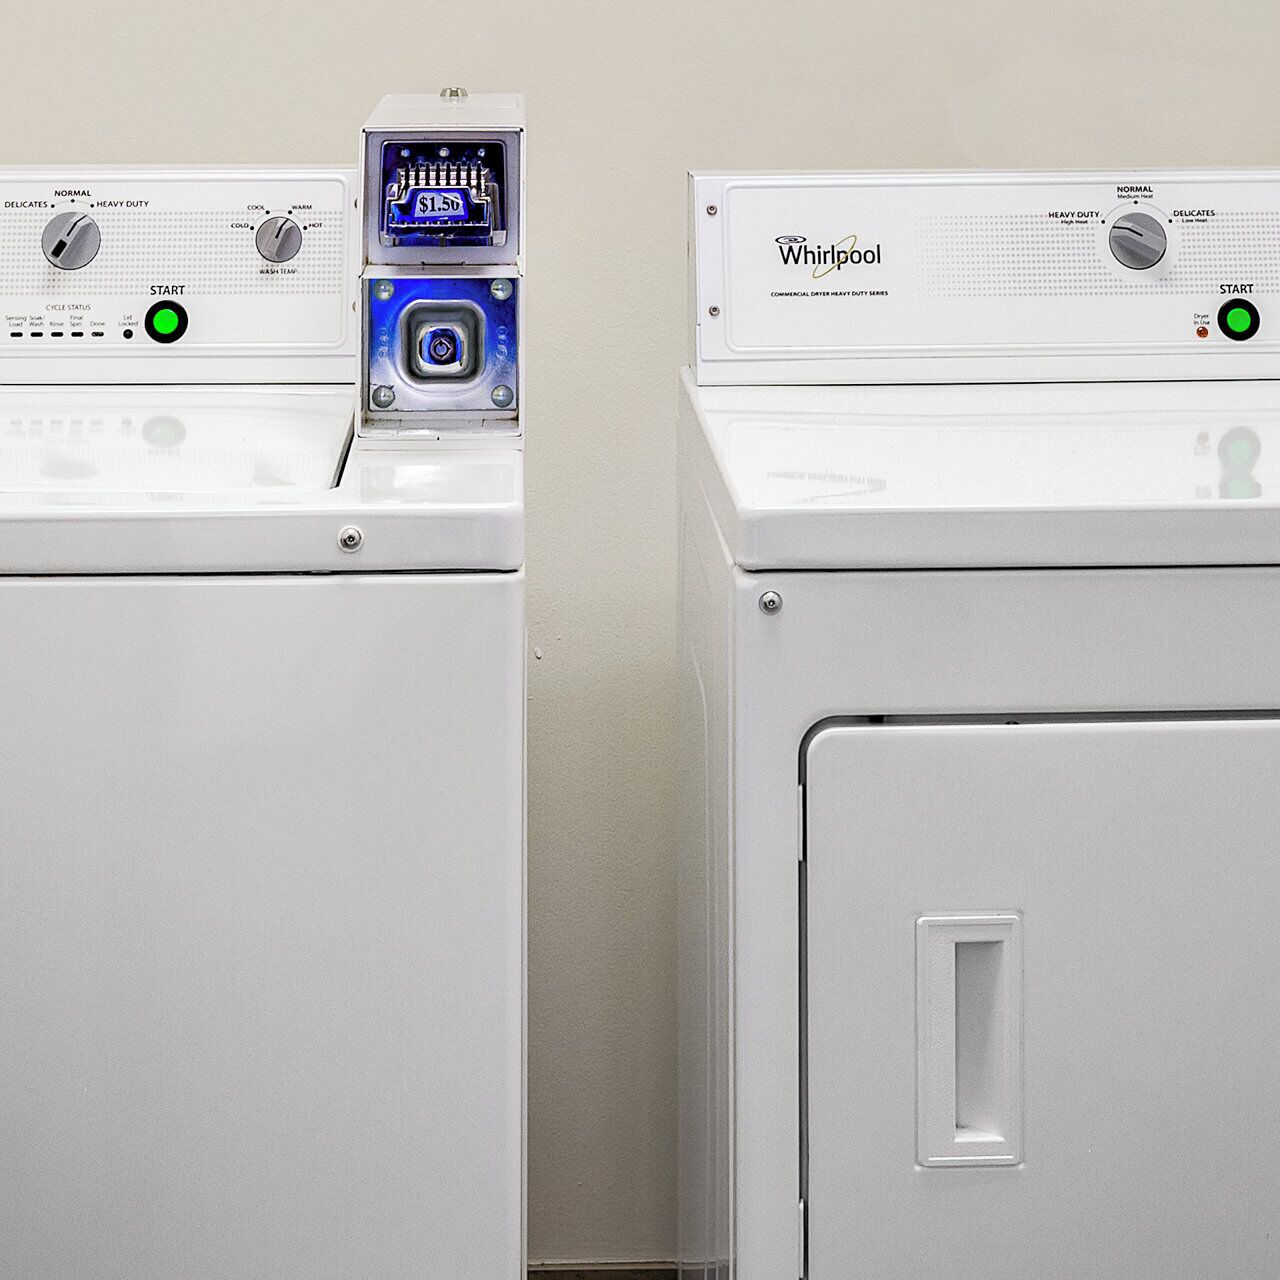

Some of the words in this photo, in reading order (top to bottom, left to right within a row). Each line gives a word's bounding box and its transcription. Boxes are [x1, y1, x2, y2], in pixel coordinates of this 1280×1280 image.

[4, 200, 48, 208] DELICATES
[96, 200, 125, 208] HEAVY
[126, 200, 150, 208] DUTY
[419, 195, 460, 214] $1.50
[1173, 209, 1216, 217] DELICATES
[778, 244, 881, 271] Whirlpool
[150, 285, 186, 296] START
[1219, 283, 1254, 294] START
